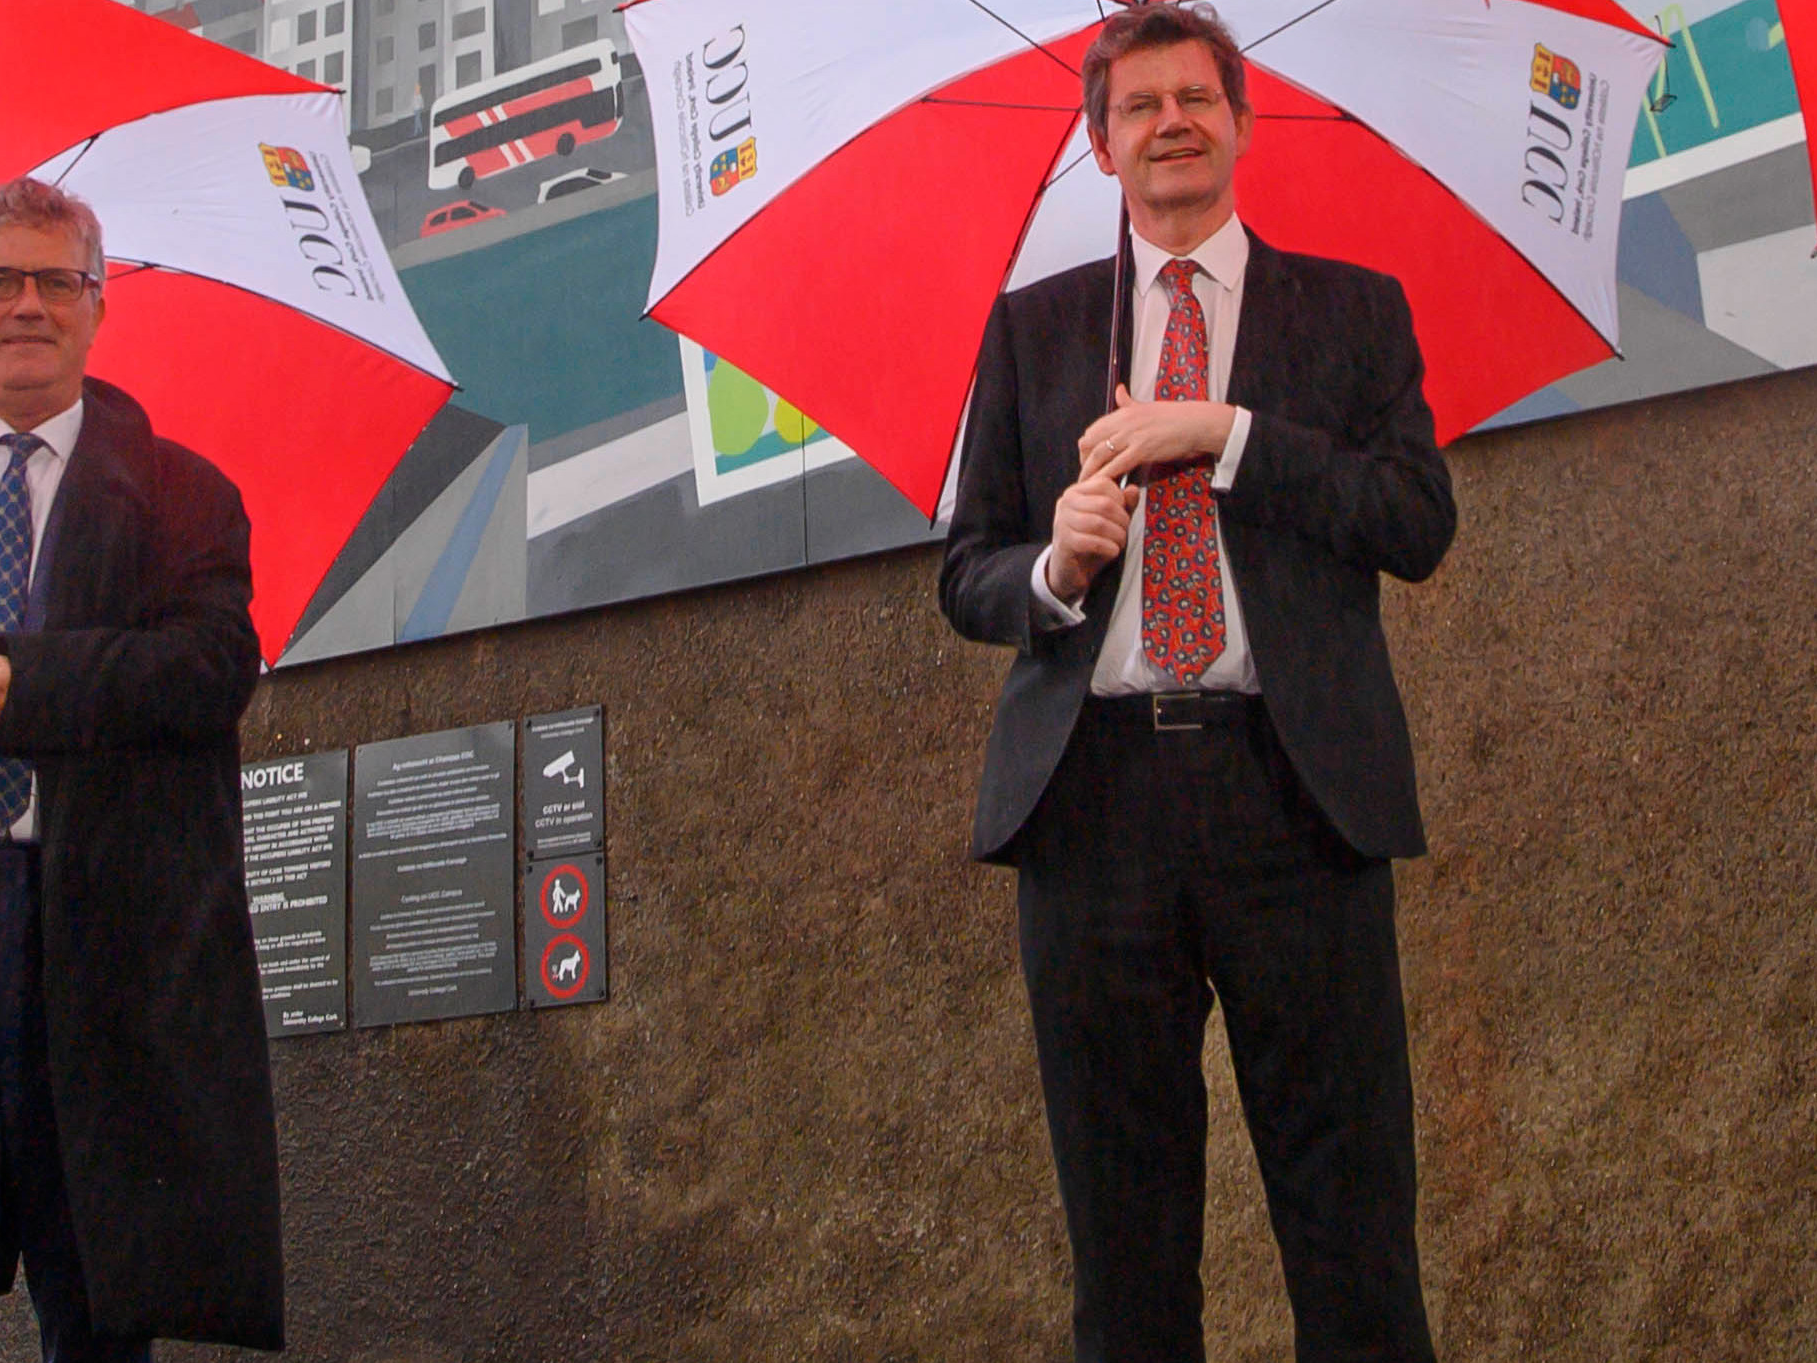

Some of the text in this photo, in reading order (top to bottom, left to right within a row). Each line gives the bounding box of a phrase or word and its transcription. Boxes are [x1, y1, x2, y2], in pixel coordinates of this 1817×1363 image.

[240, 762, 304, 790] NOTICE
[543, 803, 562, 815] CCTV
[535, 817, 555, 828] CCTV
